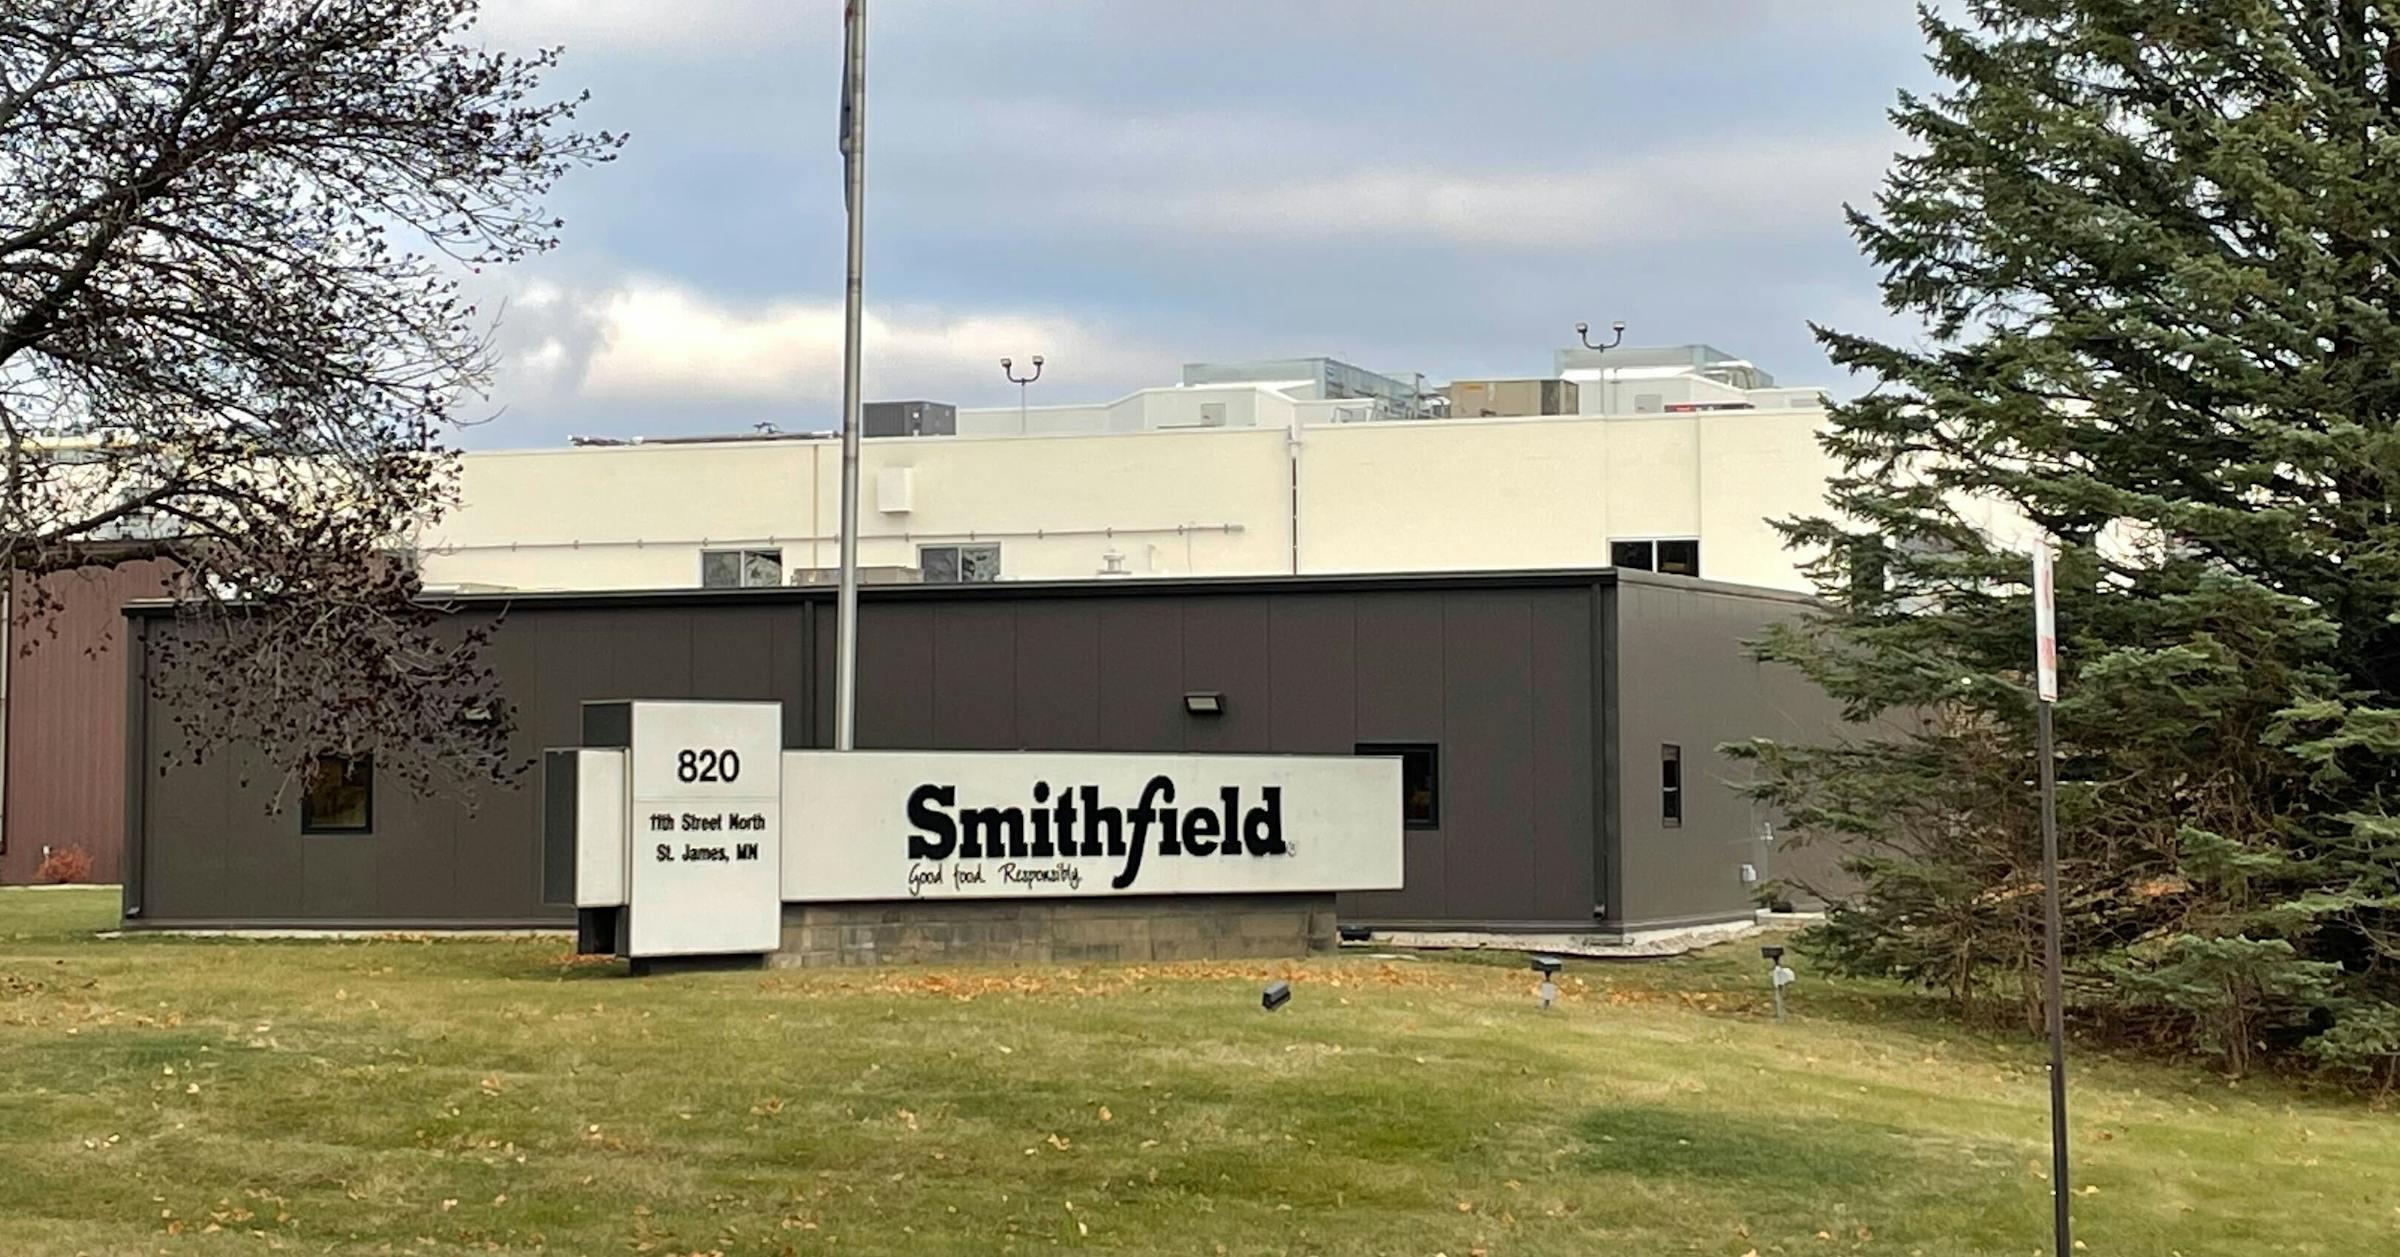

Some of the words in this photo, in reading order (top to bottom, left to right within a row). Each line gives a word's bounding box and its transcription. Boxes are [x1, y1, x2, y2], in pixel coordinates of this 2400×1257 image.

[677, 749, 740, 782] 820
[650, 813, 675, 831] 11th
[681, 813, 722, 831] Street
[729, 813, 766, 831] North
[907, 775, 1286, 889] Smithfield
[656, 843, 675, 862] St.
[681, 843, 730, 863] James,
[736, 843, 758, 861] MN
[908, 863, 943, 896] Good
